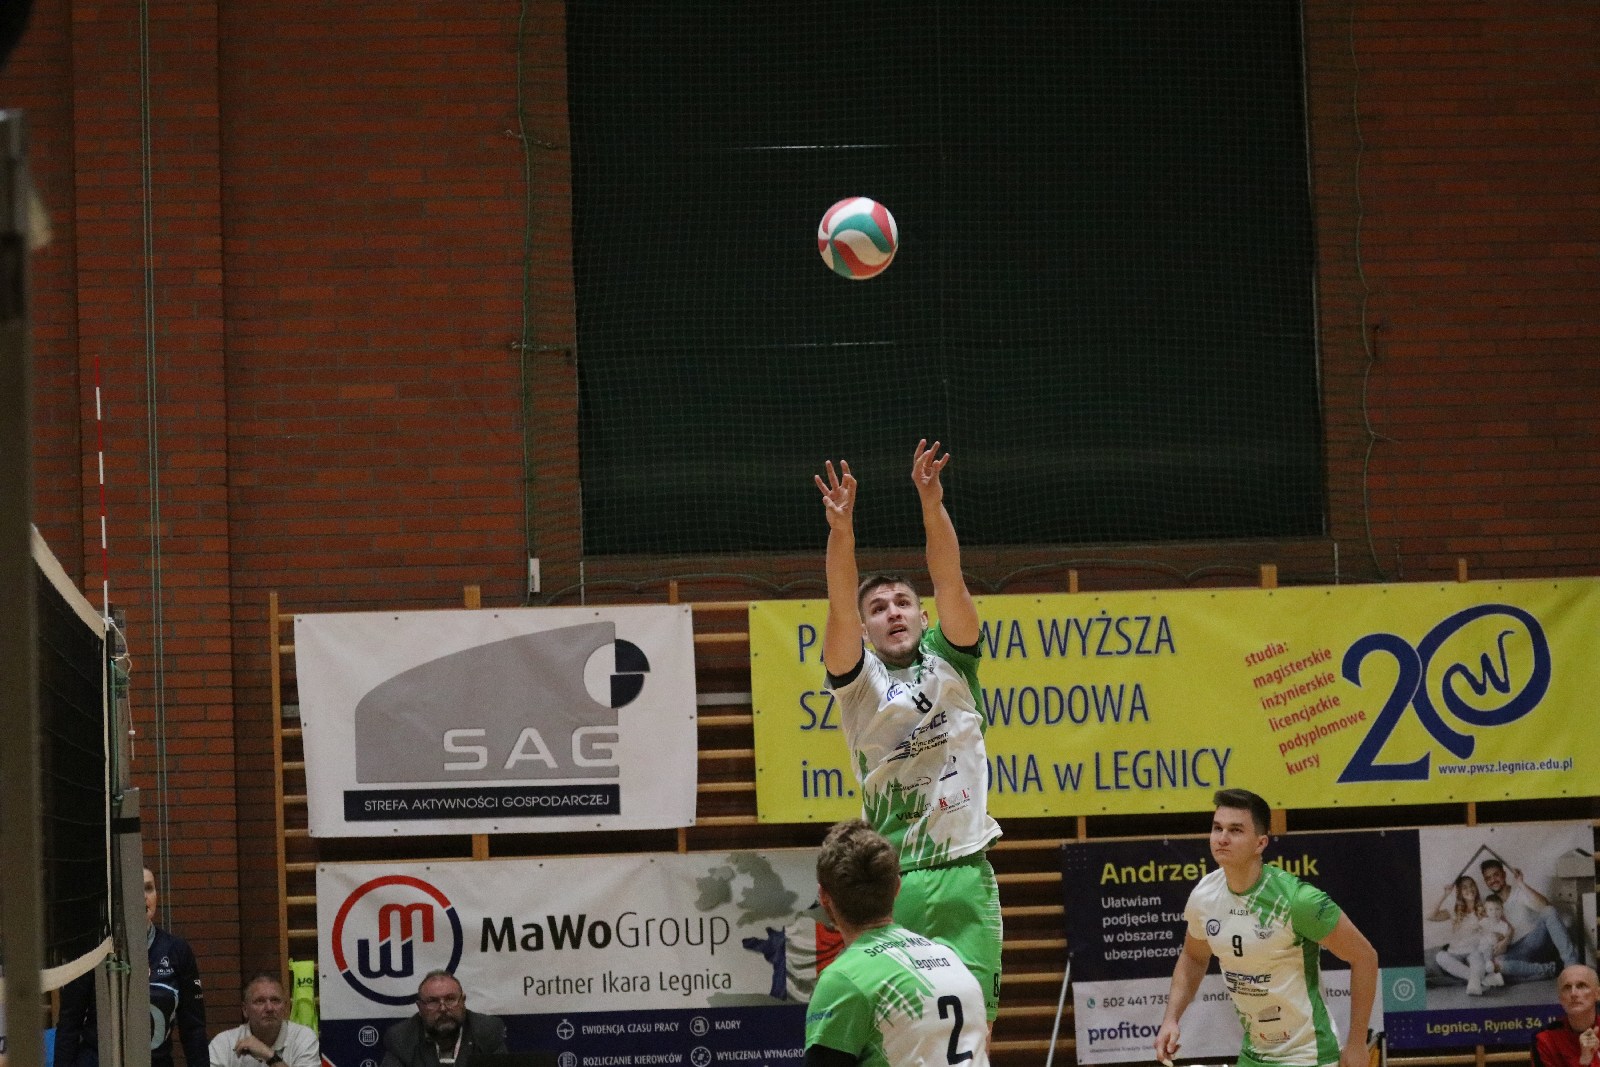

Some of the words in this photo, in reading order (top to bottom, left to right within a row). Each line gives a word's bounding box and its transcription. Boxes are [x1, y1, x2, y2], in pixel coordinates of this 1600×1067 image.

[1037, 610, 1176, 658] WYŻSZA
[1244, 641, 1289, 667] studia:
[1253, 649, 1333, 688] magisterskie
[1261, 672, 1336, 710] inżynierskie
[800, 691, 838, 730] SZ
[982, 684, 1149, 726] WODOWA
[1269, 696, 1340, 732] licencjackie
[1279, 710, 1366, 757] podyplomowe
[443, 725, 619, 771] SAG
[802, 760, 854, 797] im.
[1054, 763, 1083, 791] w
[1095, 748, 1231, 790] LEGNICY
[1285, 753, 1320, 775] kursy
[1438, 757, 1573, 775] www.pwsz.legnica.edu.pl
[364, 799, 409, 811] STREFA
[411, 795, 498, 811] AKTYWNOŚCI
[502, 794, 609, 807] GOSPODARCZEJ
[1102, 911, 1159, 929] podjęcie
[480, 911, 731, 956] MaWoGroup
[1103, 933, 1115, 943] w
[1116, 930, 1173, 943] obszarze
[1231, 934, 1244, 958] 9
[523, 974, 595, 997] Partner
[602, 970, 650, 994] Ikara
[659, 968, 732, 997] Legnica
[1102, 997, 1125, 1008] 502
[1128, 996, 1148, 1007] 441
[582, 1024, 626, 1037] EWIDENCJA
[628, 1023, 652, 1034] CZASU
[654, 1022, 680, 1033] PRACY
[715, 1020, 741, 1031] KADRY
[937, 995, 974, 1066] 2
[1426, 1020, 1481, 1037] Legnica,
[1484, 1019, 1523, 1034] Rynek
[1525, 1017, 1542, 1029] 34
[582, 1055, 632, 1067] ROZLICZANIE
[634, 1052, 683, 1065] KIEROWCÓW
[716, 1050, 762, 1062] WYLICZENIA
